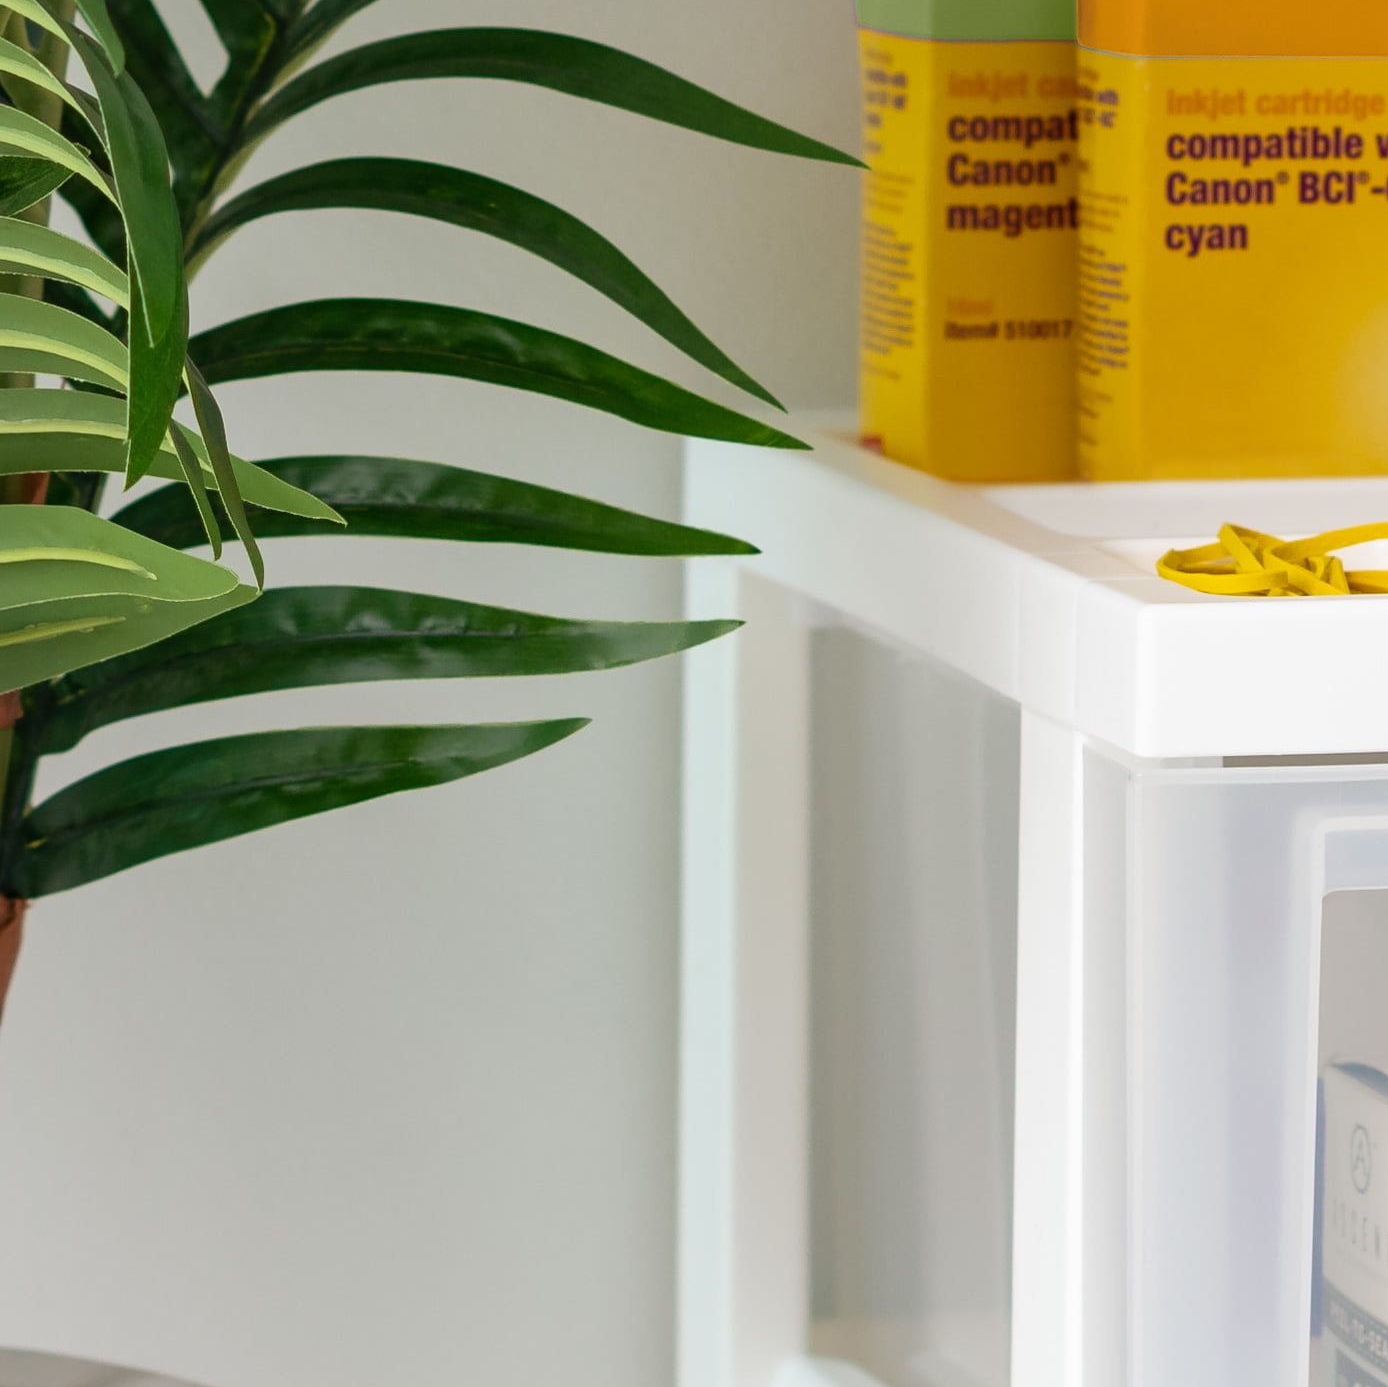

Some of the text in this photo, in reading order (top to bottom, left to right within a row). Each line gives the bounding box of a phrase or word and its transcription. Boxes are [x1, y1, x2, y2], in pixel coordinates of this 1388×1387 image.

[947, 72, 1028, 103] inkjet
[1167, 89, 1387, 121] inkjet cartridge
[1166, 126, 1364, 167] compatible
[1164, 222, 1249, 258] cyan
